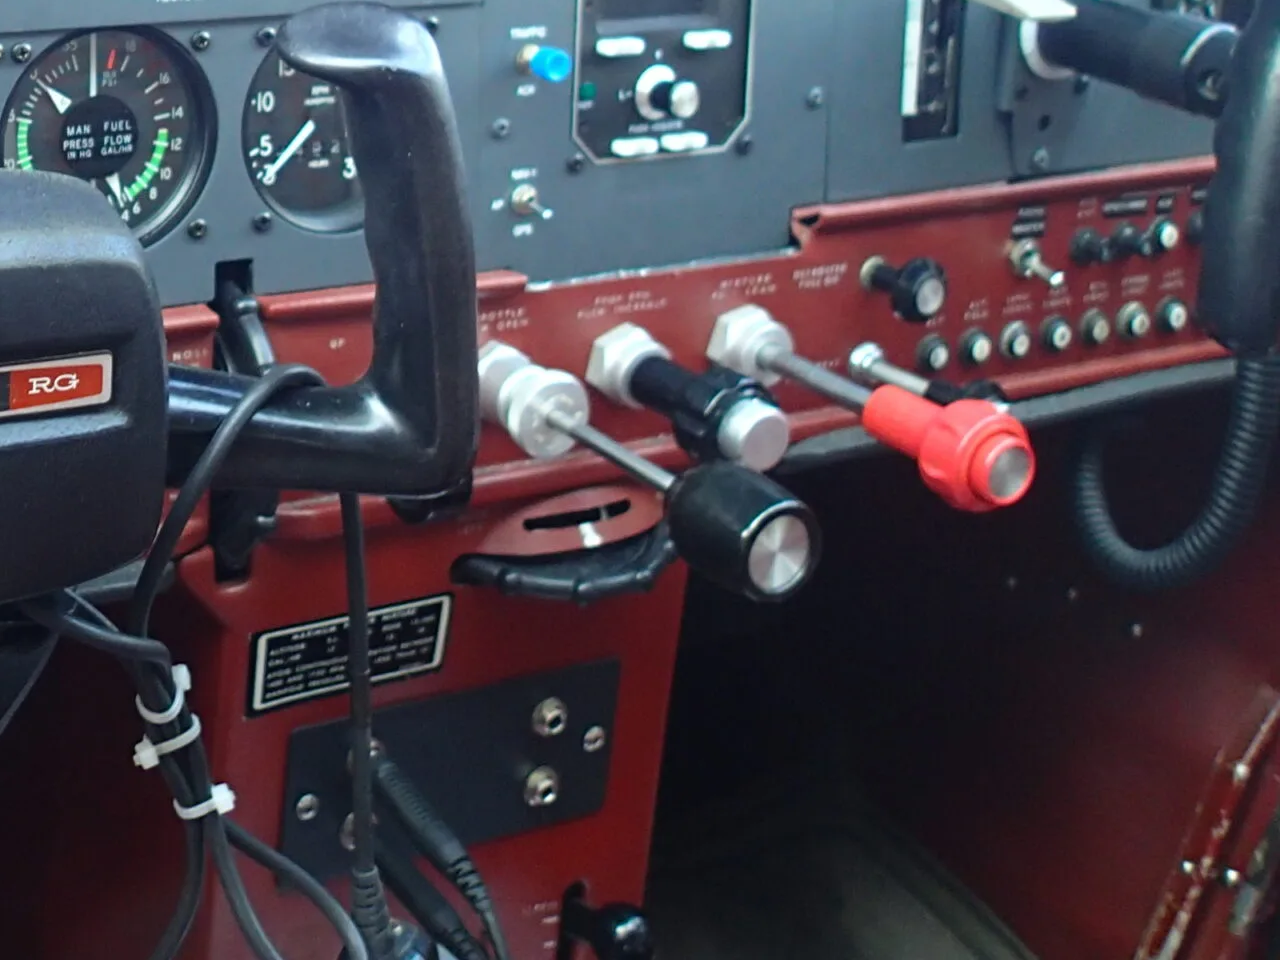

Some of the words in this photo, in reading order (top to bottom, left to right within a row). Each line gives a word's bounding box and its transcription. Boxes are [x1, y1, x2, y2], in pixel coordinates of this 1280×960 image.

[159, 72, 170, 84] 16
[257, 91, 275, 112] 10
[171, 106, 184, 119] 14
[67, 125, 91, 136] MAN
[103, 120, 132, 131] FUEL
[63, 139, 95, 151] PRESS
[104, 134, 132, 146] FLOW
[170, 137, 182, 151] 12
[260, 135, 273, 157] 5
[100, 144, 133, 156] GAL/HR
[160, 169, 171, 180] 10
[149, 187, 158, 200] 8
[121, 208, 131, 221] 4
[132, 203, 141, 215] 6
[28, 373, 80, 395] RG
